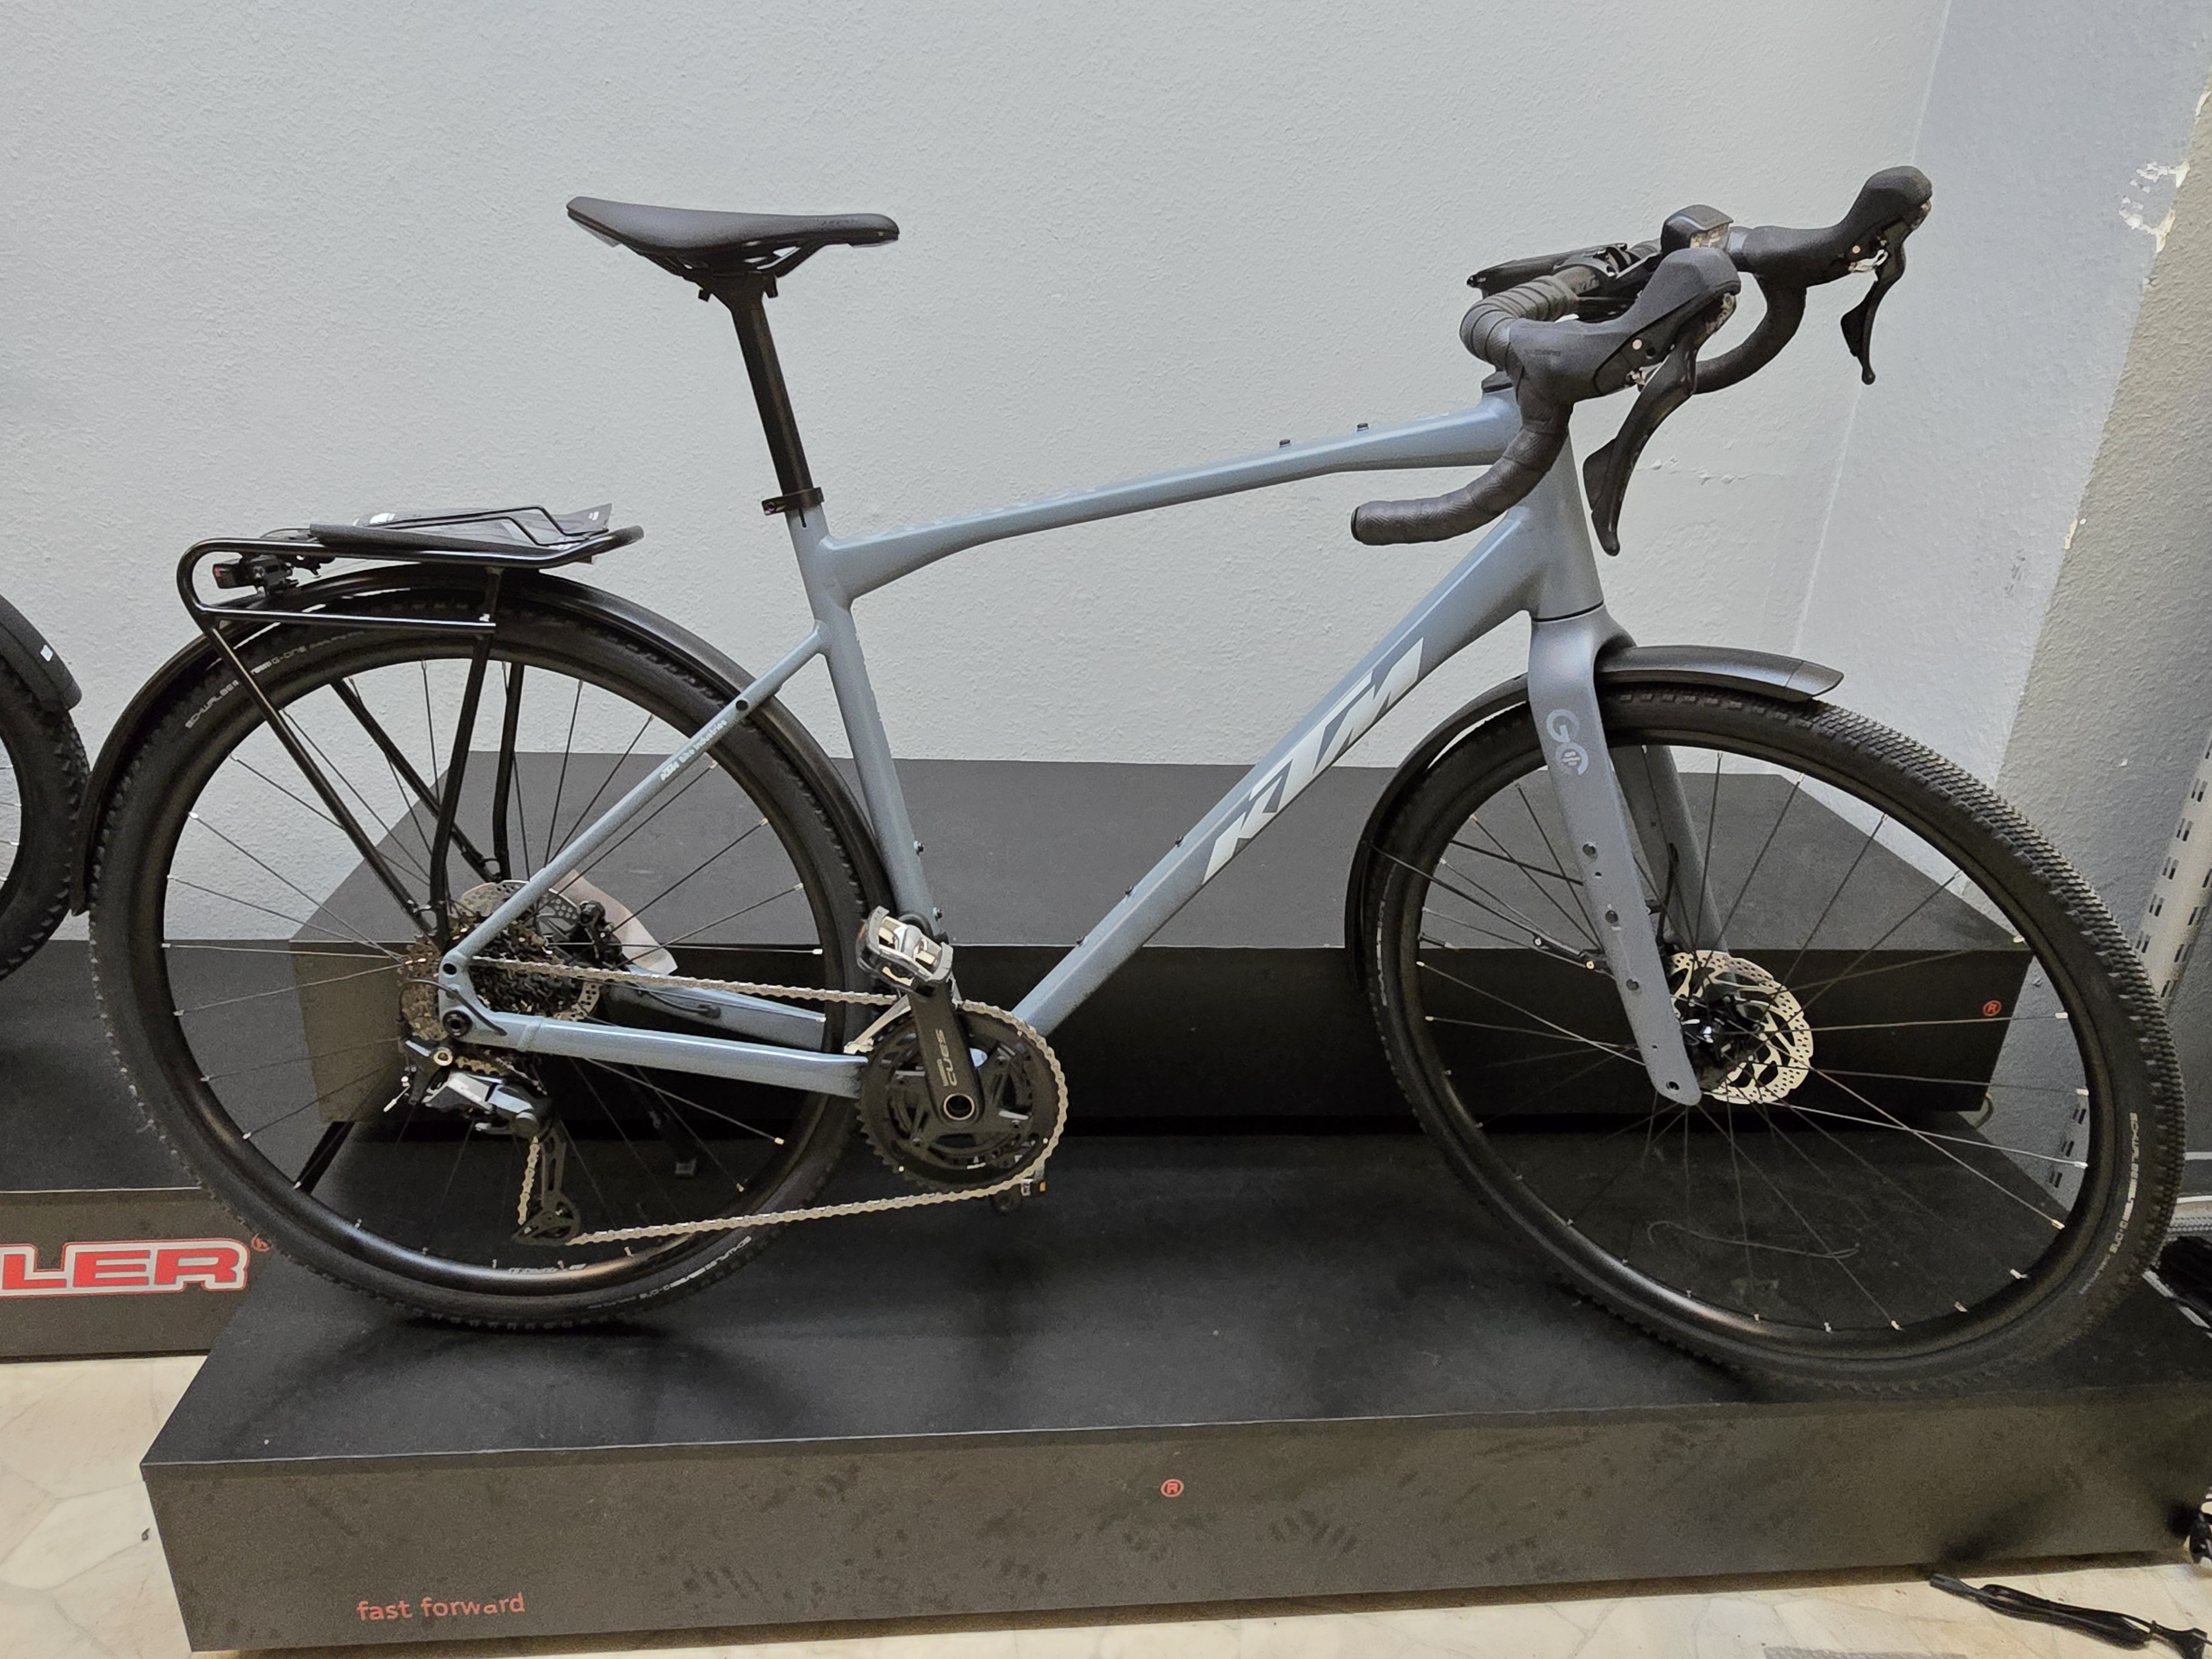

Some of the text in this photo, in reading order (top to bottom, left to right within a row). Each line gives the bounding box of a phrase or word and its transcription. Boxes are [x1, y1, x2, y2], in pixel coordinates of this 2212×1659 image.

[679, 749, 695, 763] Bike
[693, 719, 727, 750] Industries
[1202, 637, 1424, 885] KTM
[935, 1029, 957, 1086] CUES
[357, 1591, 525, 1621] fast forward
